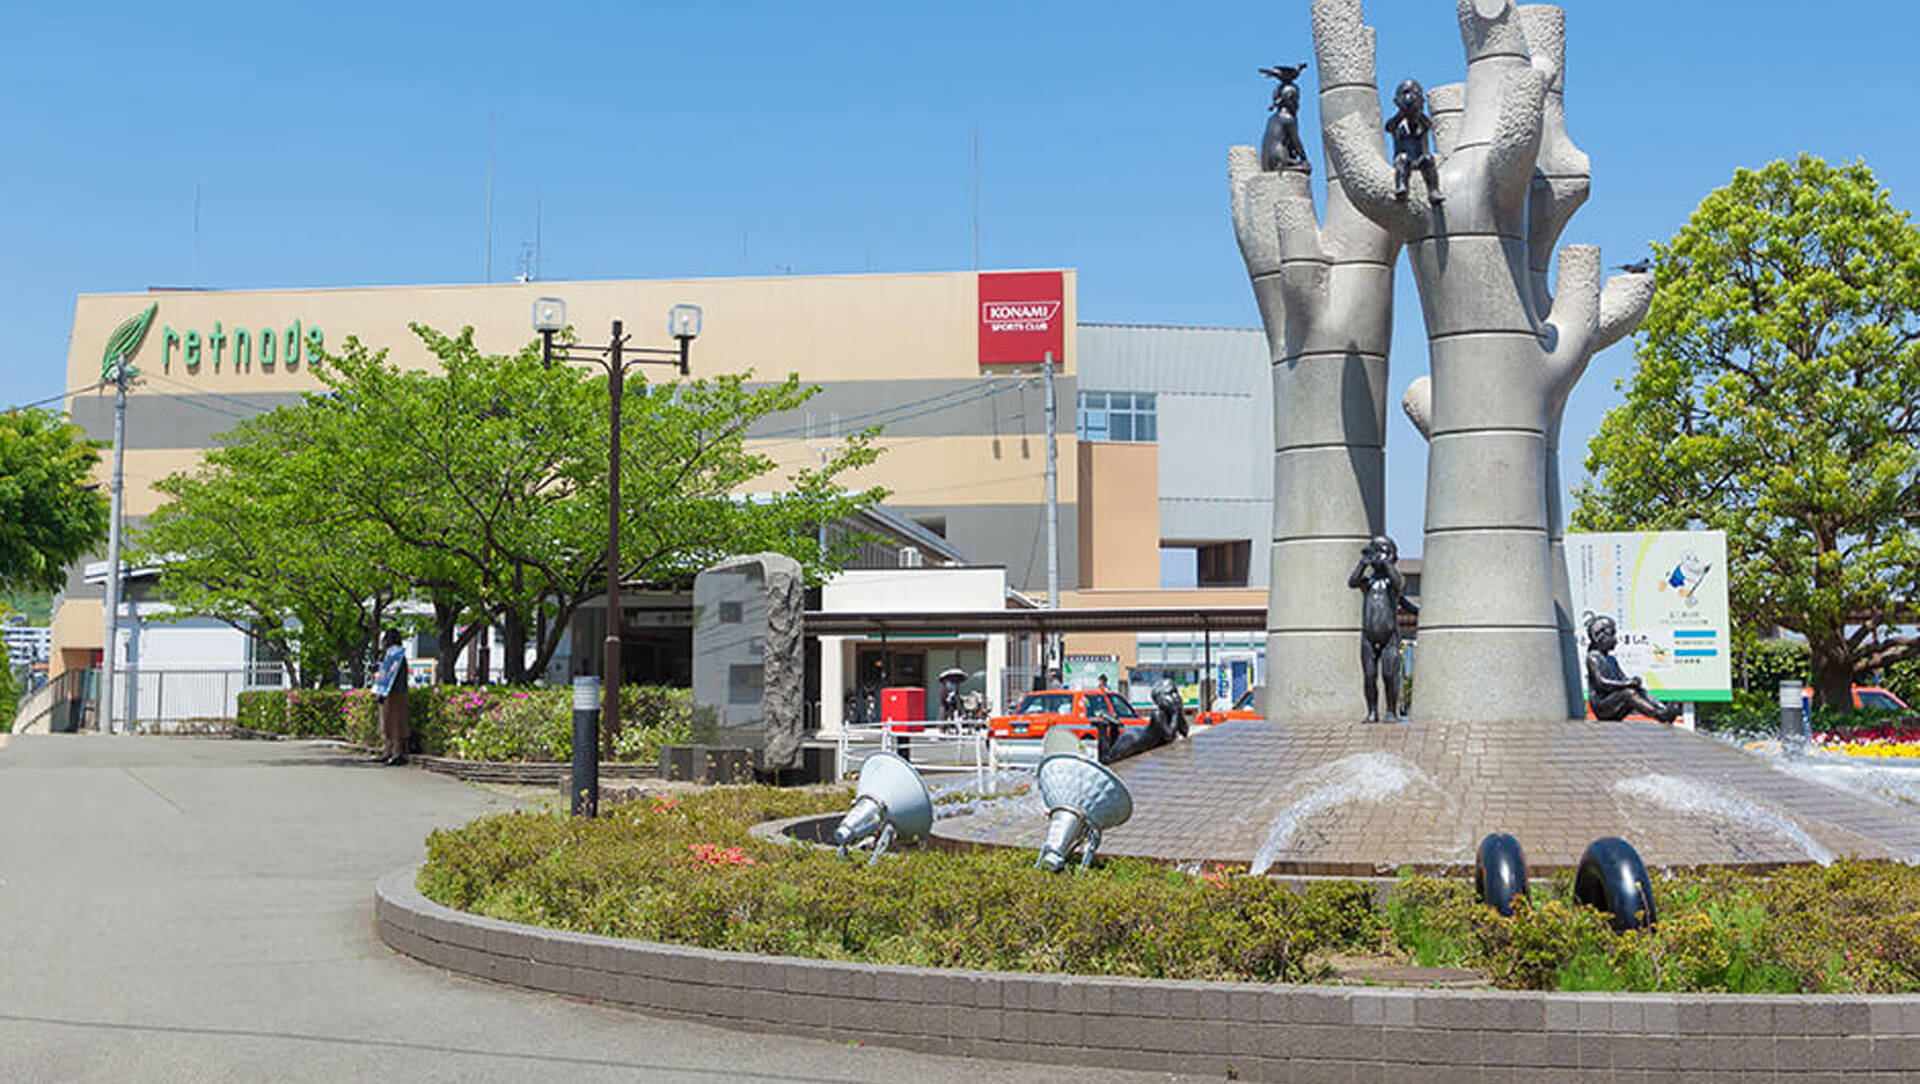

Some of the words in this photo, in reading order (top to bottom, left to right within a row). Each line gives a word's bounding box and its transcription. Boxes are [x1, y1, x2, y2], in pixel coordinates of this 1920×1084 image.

[991, 306, 1047, 318] KONAMI
[992, 323, 1023, 331] SPORTS
[1025, 322, 1048, 330] CLUB
